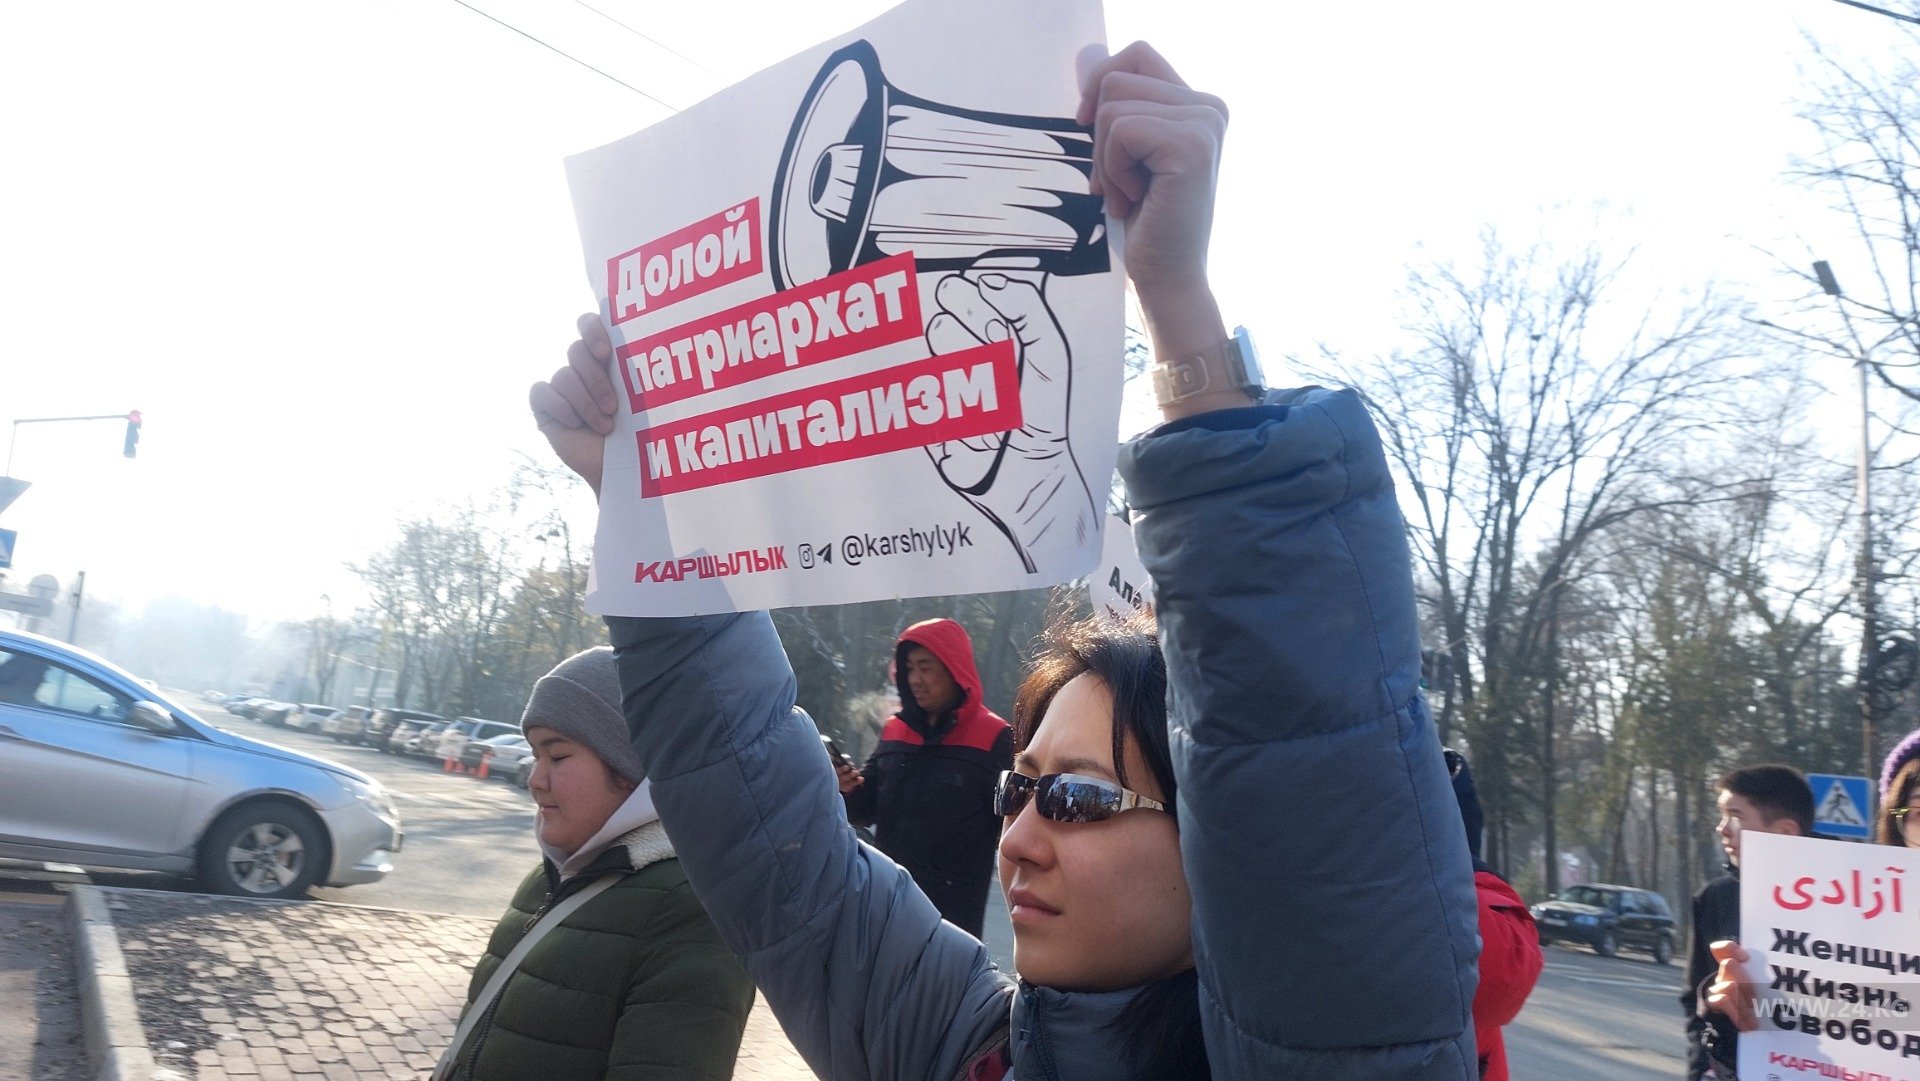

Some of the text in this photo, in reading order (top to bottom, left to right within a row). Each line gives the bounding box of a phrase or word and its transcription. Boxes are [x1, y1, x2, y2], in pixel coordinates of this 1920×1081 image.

[616, 205, 751, 319] Долой
[626, 270, 907, 395] патриархат
[646, 361, 999, 480] и капитализм
[634, 545, 788, 583] КАРШЫЛЫК
[841, 521, 974, 566] @karshylyk
[1773, 866, 1905, 919] آزادی
[1769, 964, 1911, 1013] Жизнь
